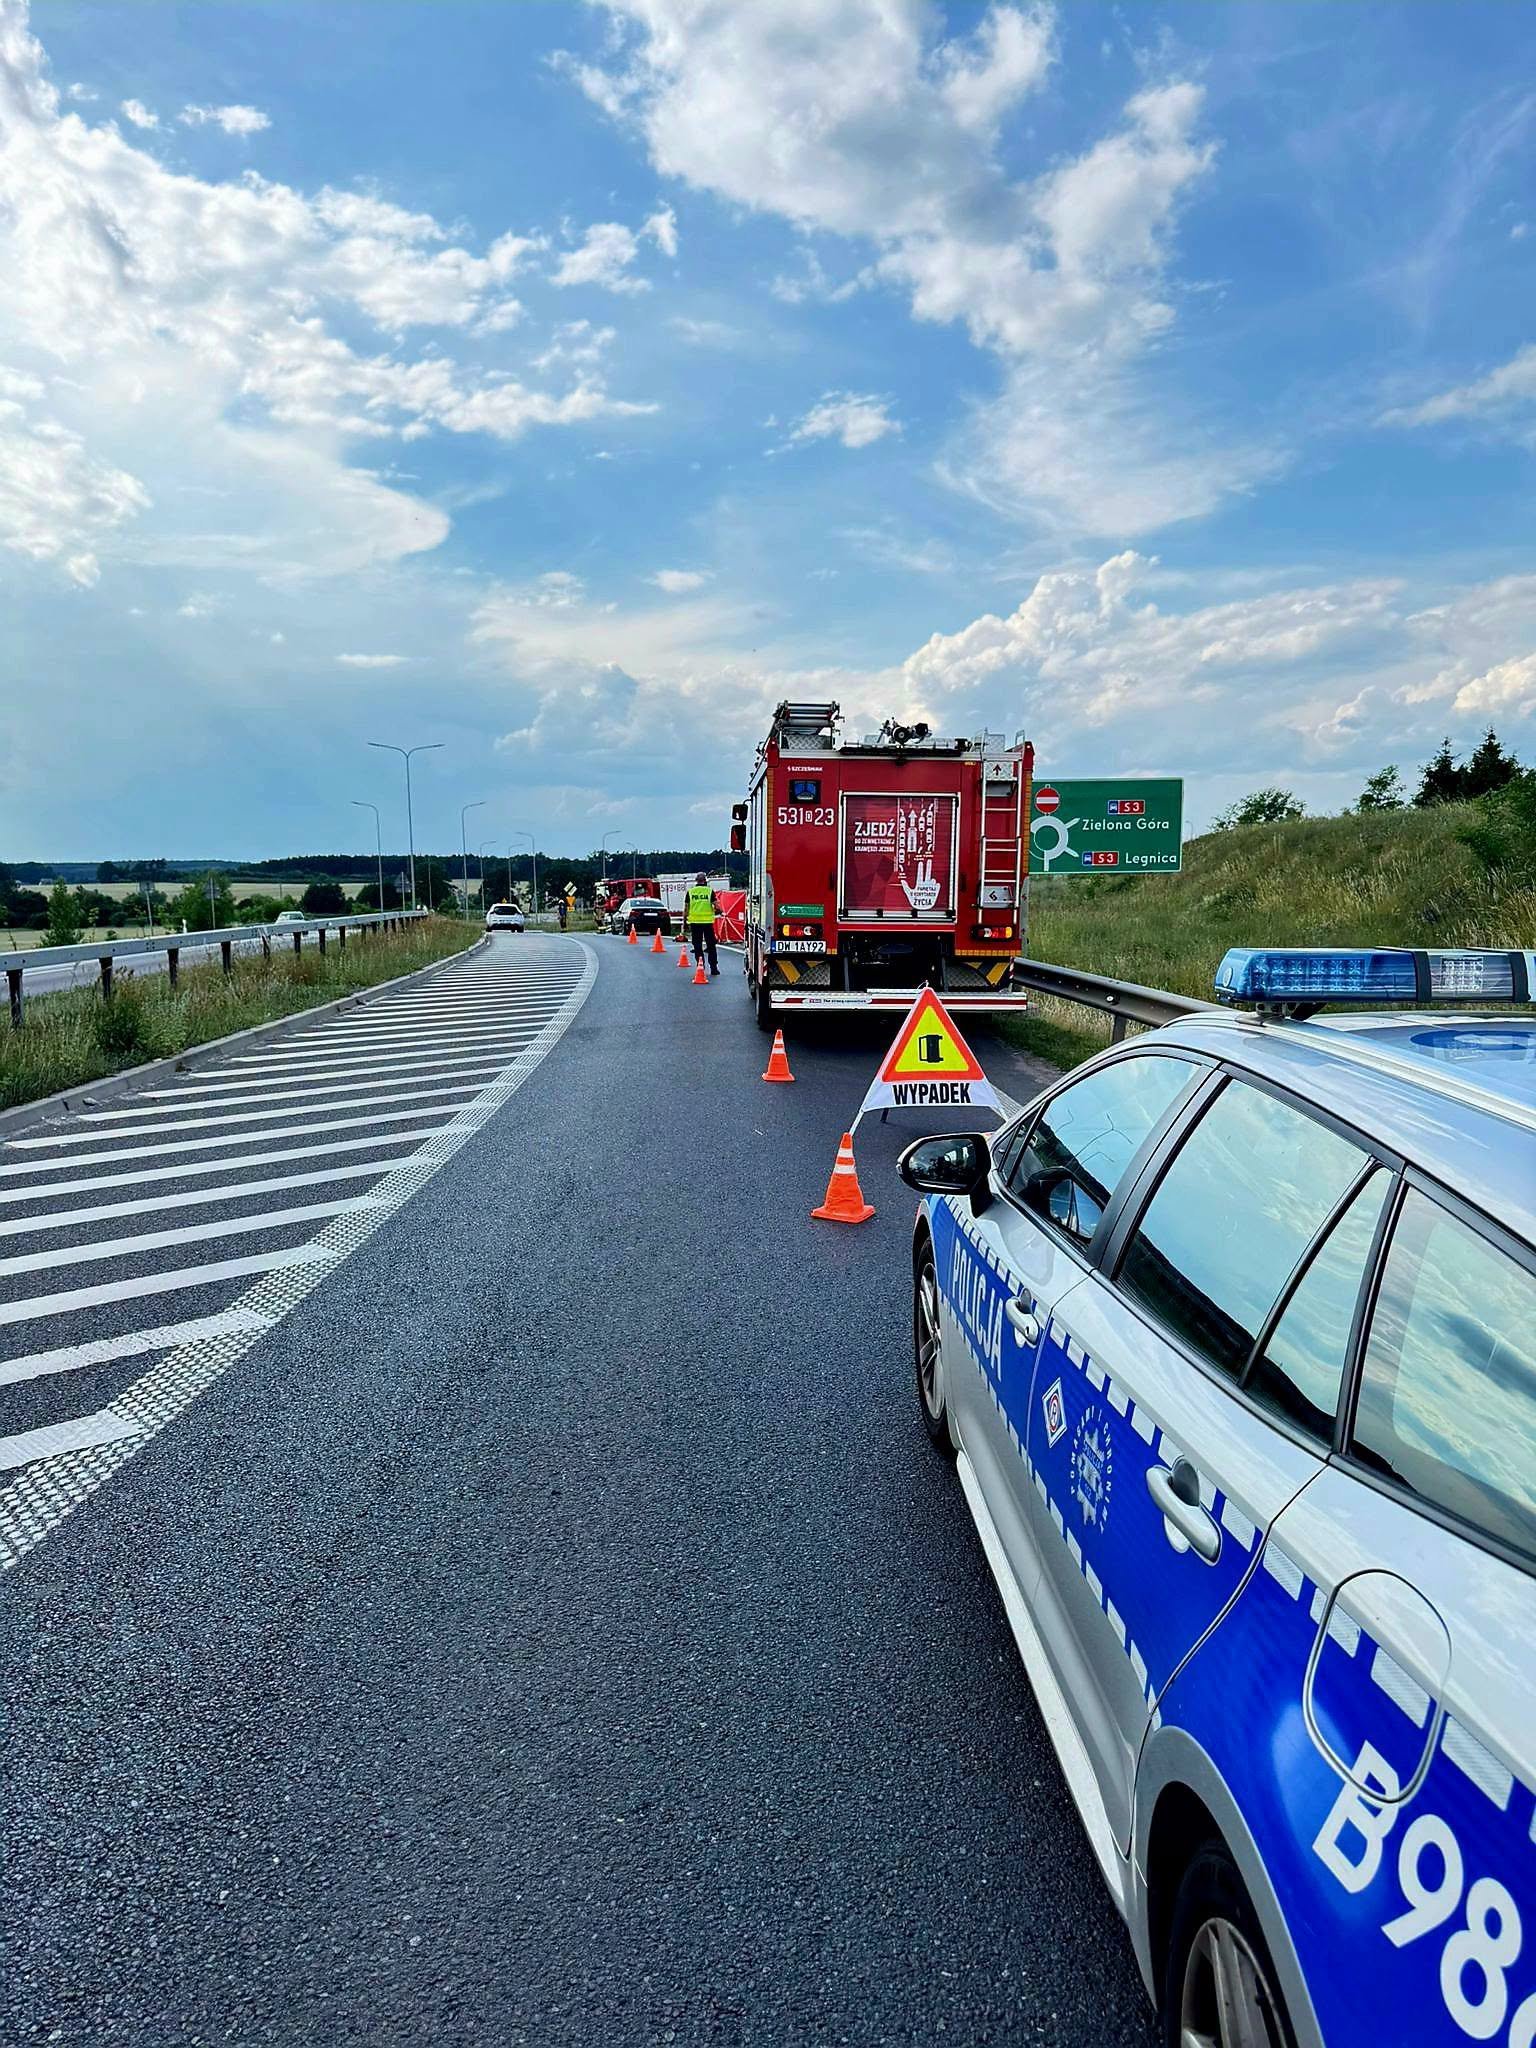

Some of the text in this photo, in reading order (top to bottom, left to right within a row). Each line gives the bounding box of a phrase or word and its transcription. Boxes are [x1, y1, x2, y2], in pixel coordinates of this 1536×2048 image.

[854, 818, 896, 837] ZJEDŹ
[1082, 818, 1170, 831] Zielona Góra
[1125, 852, 1177, 867] Legnica
[777, 941, 791, 951] DW
[892, 1082, 972, 1105] WYPADEK
[952, 1237, 1004, 1383] POLICJA
